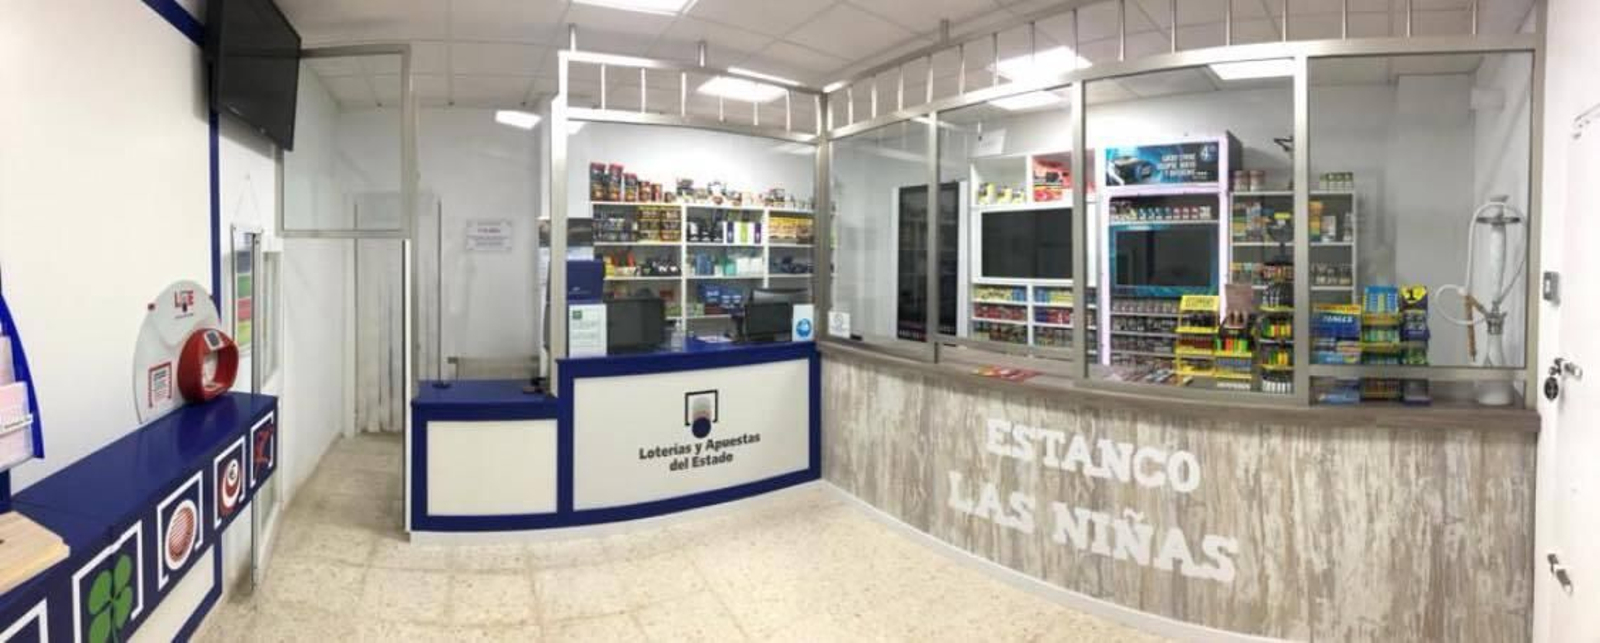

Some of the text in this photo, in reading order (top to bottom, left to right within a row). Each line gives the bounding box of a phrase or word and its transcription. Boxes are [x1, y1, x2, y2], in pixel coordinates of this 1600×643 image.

[669, 452, 733, 471] del Estado
[695, 443, 703, 455] y
[705, 433, 760, 451] Apuestas
[986, 418, 1201, 492] ESTANCO
[948, 470, 1239, 583] LAS NIÑAS
